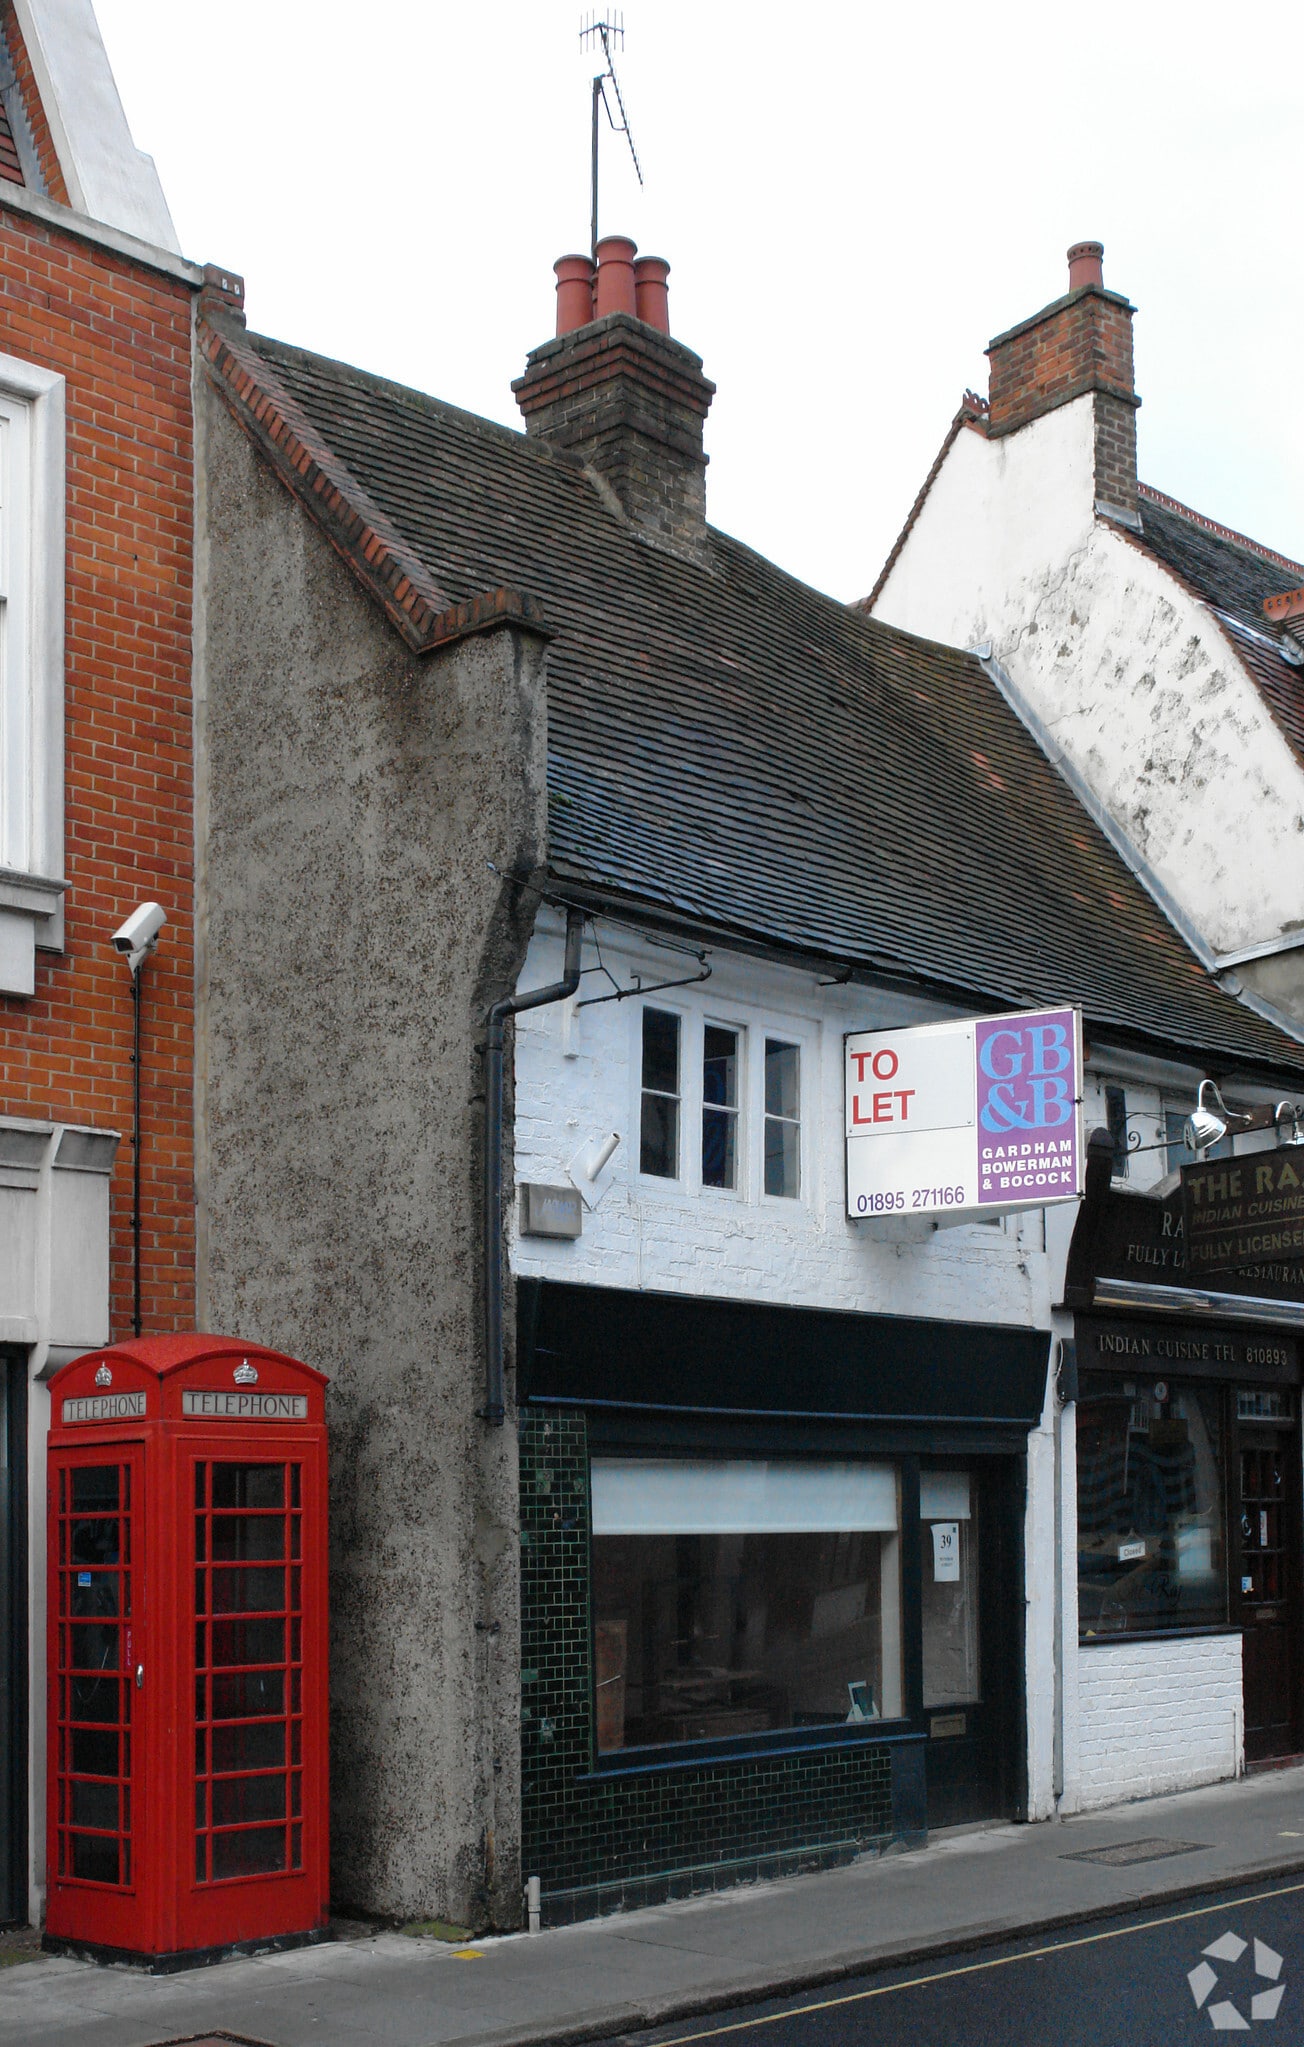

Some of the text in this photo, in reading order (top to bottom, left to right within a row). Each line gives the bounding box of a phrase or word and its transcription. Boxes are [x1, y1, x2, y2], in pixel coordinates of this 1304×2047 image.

[850, 1049, 899, 1083] TO
[980, 1023, 1071, 1081] GB
[852, 1089, 916, 1125] LET
[980, 1078, 1073, 1134] &B
[982, 1140, 1072, 1159] GARDHAM
[982, 1156, 1072, 1175] BOWERMAN
[982, 1170, 1072, 1190] & BOCOCK
[1188, 1162, 1304, 1204] THE RA
[857, 1185, 966, 1213] 01895 271166
[1191, 1195, 1304, 1224] INDIAN CUISINE
[1127, 1244, 1171, 1266] FULLY
[1191, 1229, 1304, 1262] FULLY LICENSE
[1099, 1334, 1151, 1355] INDIAN
[1156, 1340, 1209, 1361] CUISINE
[1246, 1347, 1288, 1366] 810893
[68, 1393, 145, 1420] TELEPHONE
[187, 1394, 302, 1417] TELEPHONE
[940, 1534, 952, 1549] 39
